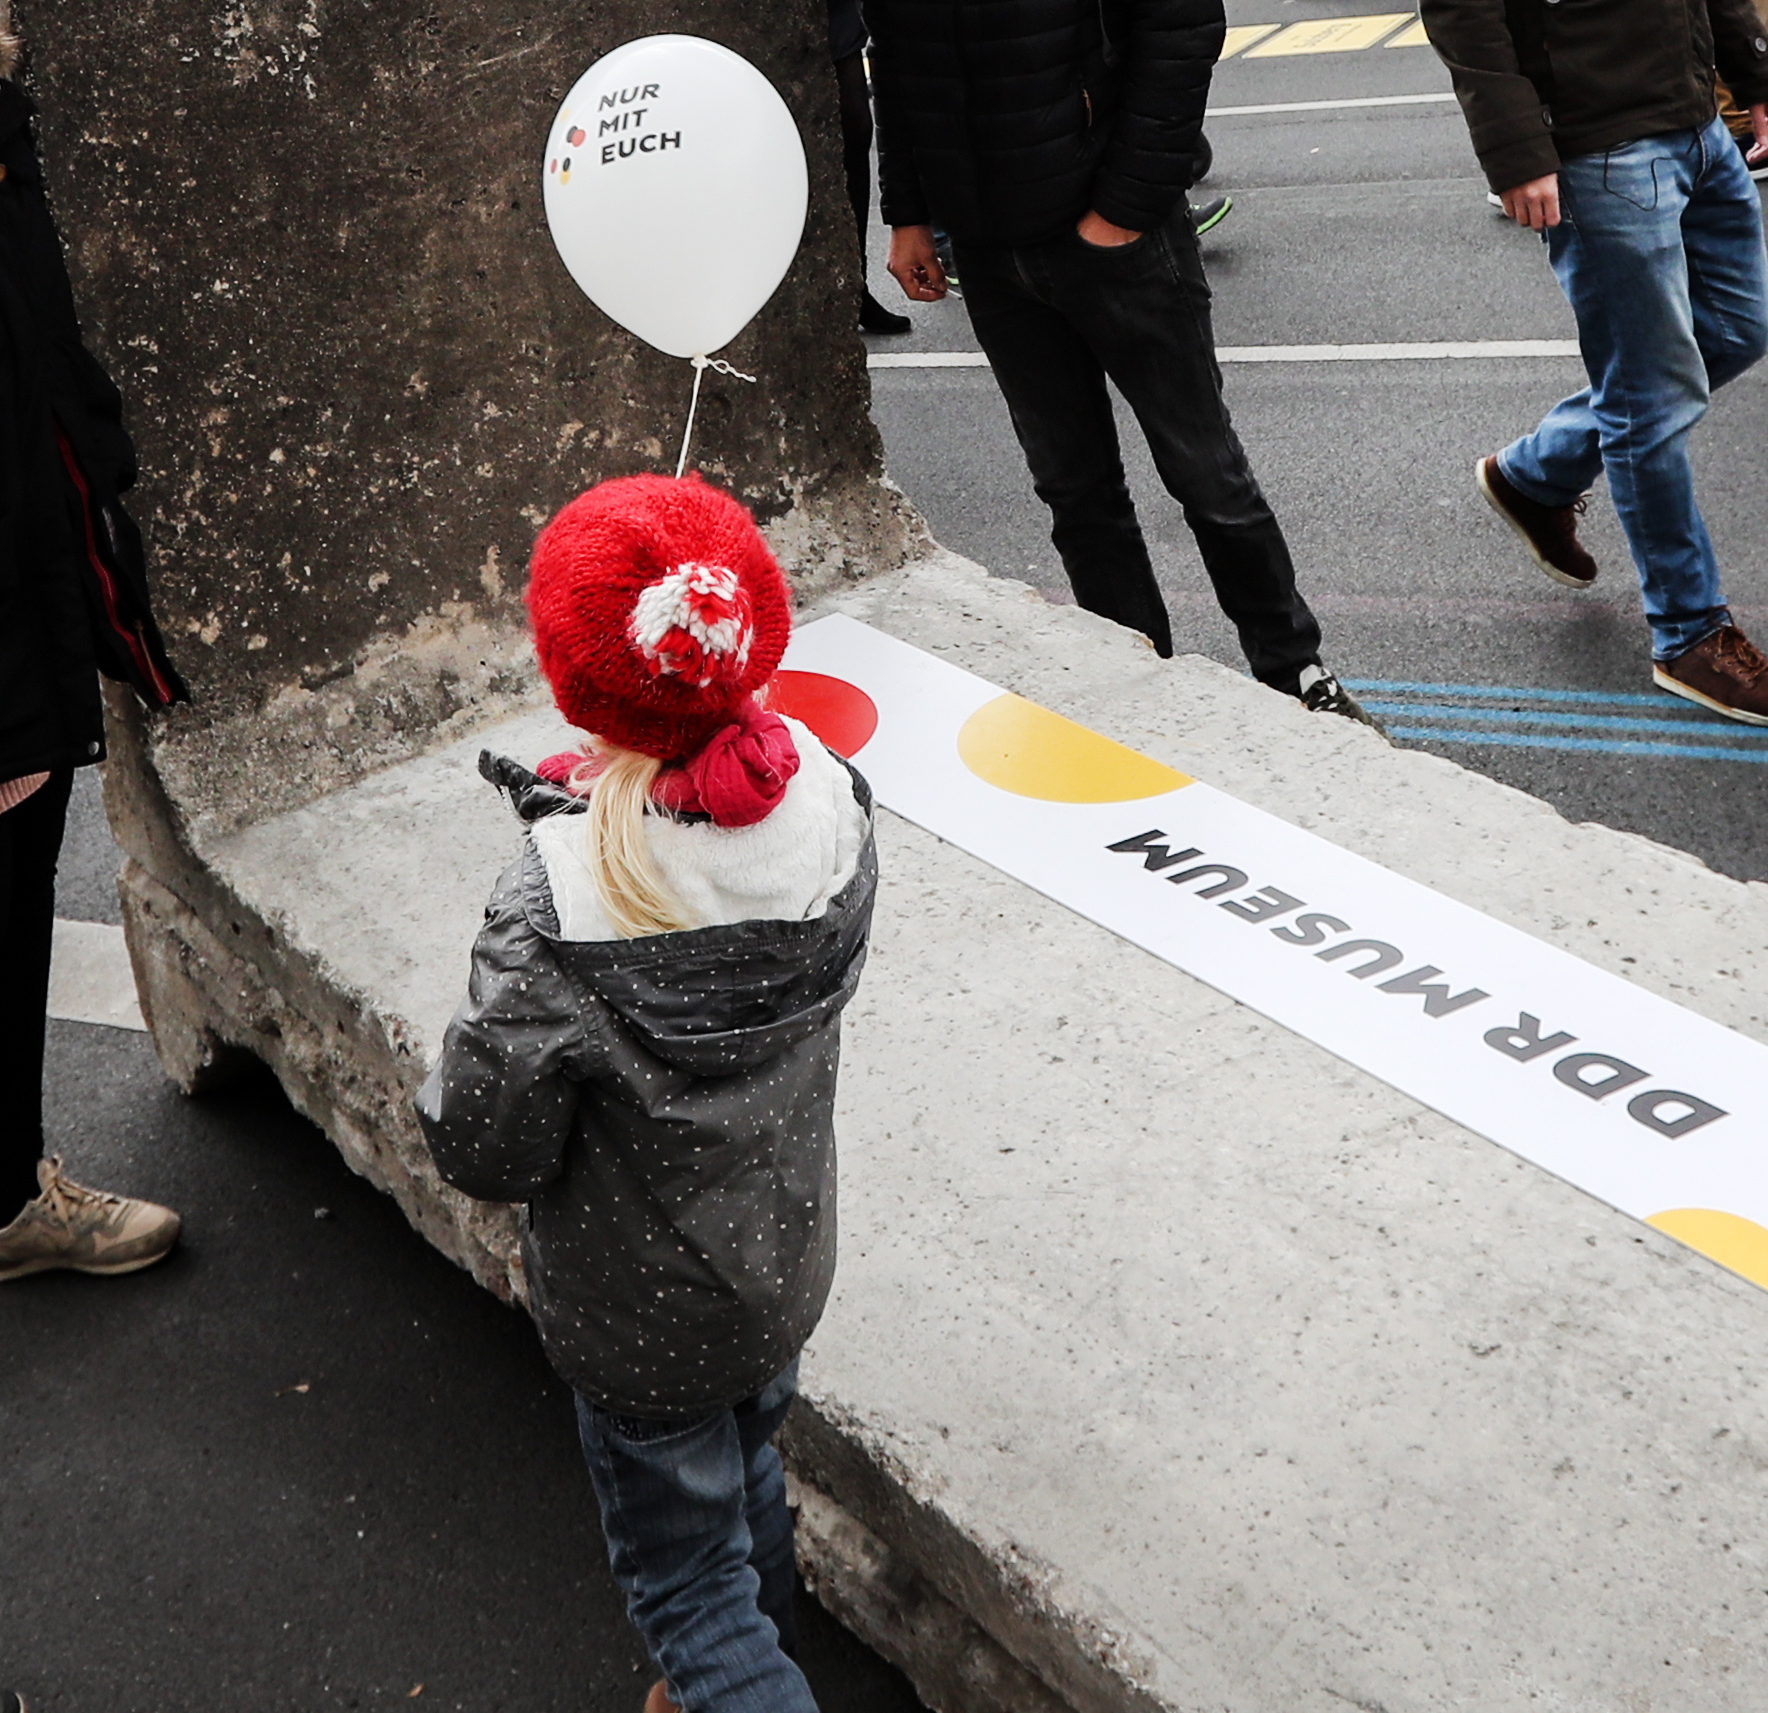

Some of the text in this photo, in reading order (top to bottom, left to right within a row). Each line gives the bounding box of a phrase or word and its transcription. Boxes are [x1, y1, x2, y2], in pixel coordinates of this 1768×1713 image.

[598, 84, 661, 111] NUR
[598, 109, 648, 137] MIT
[601, 131, 681, 165] EUCH
[1105, 829, 1730, 1139] DDR MUSEUM
